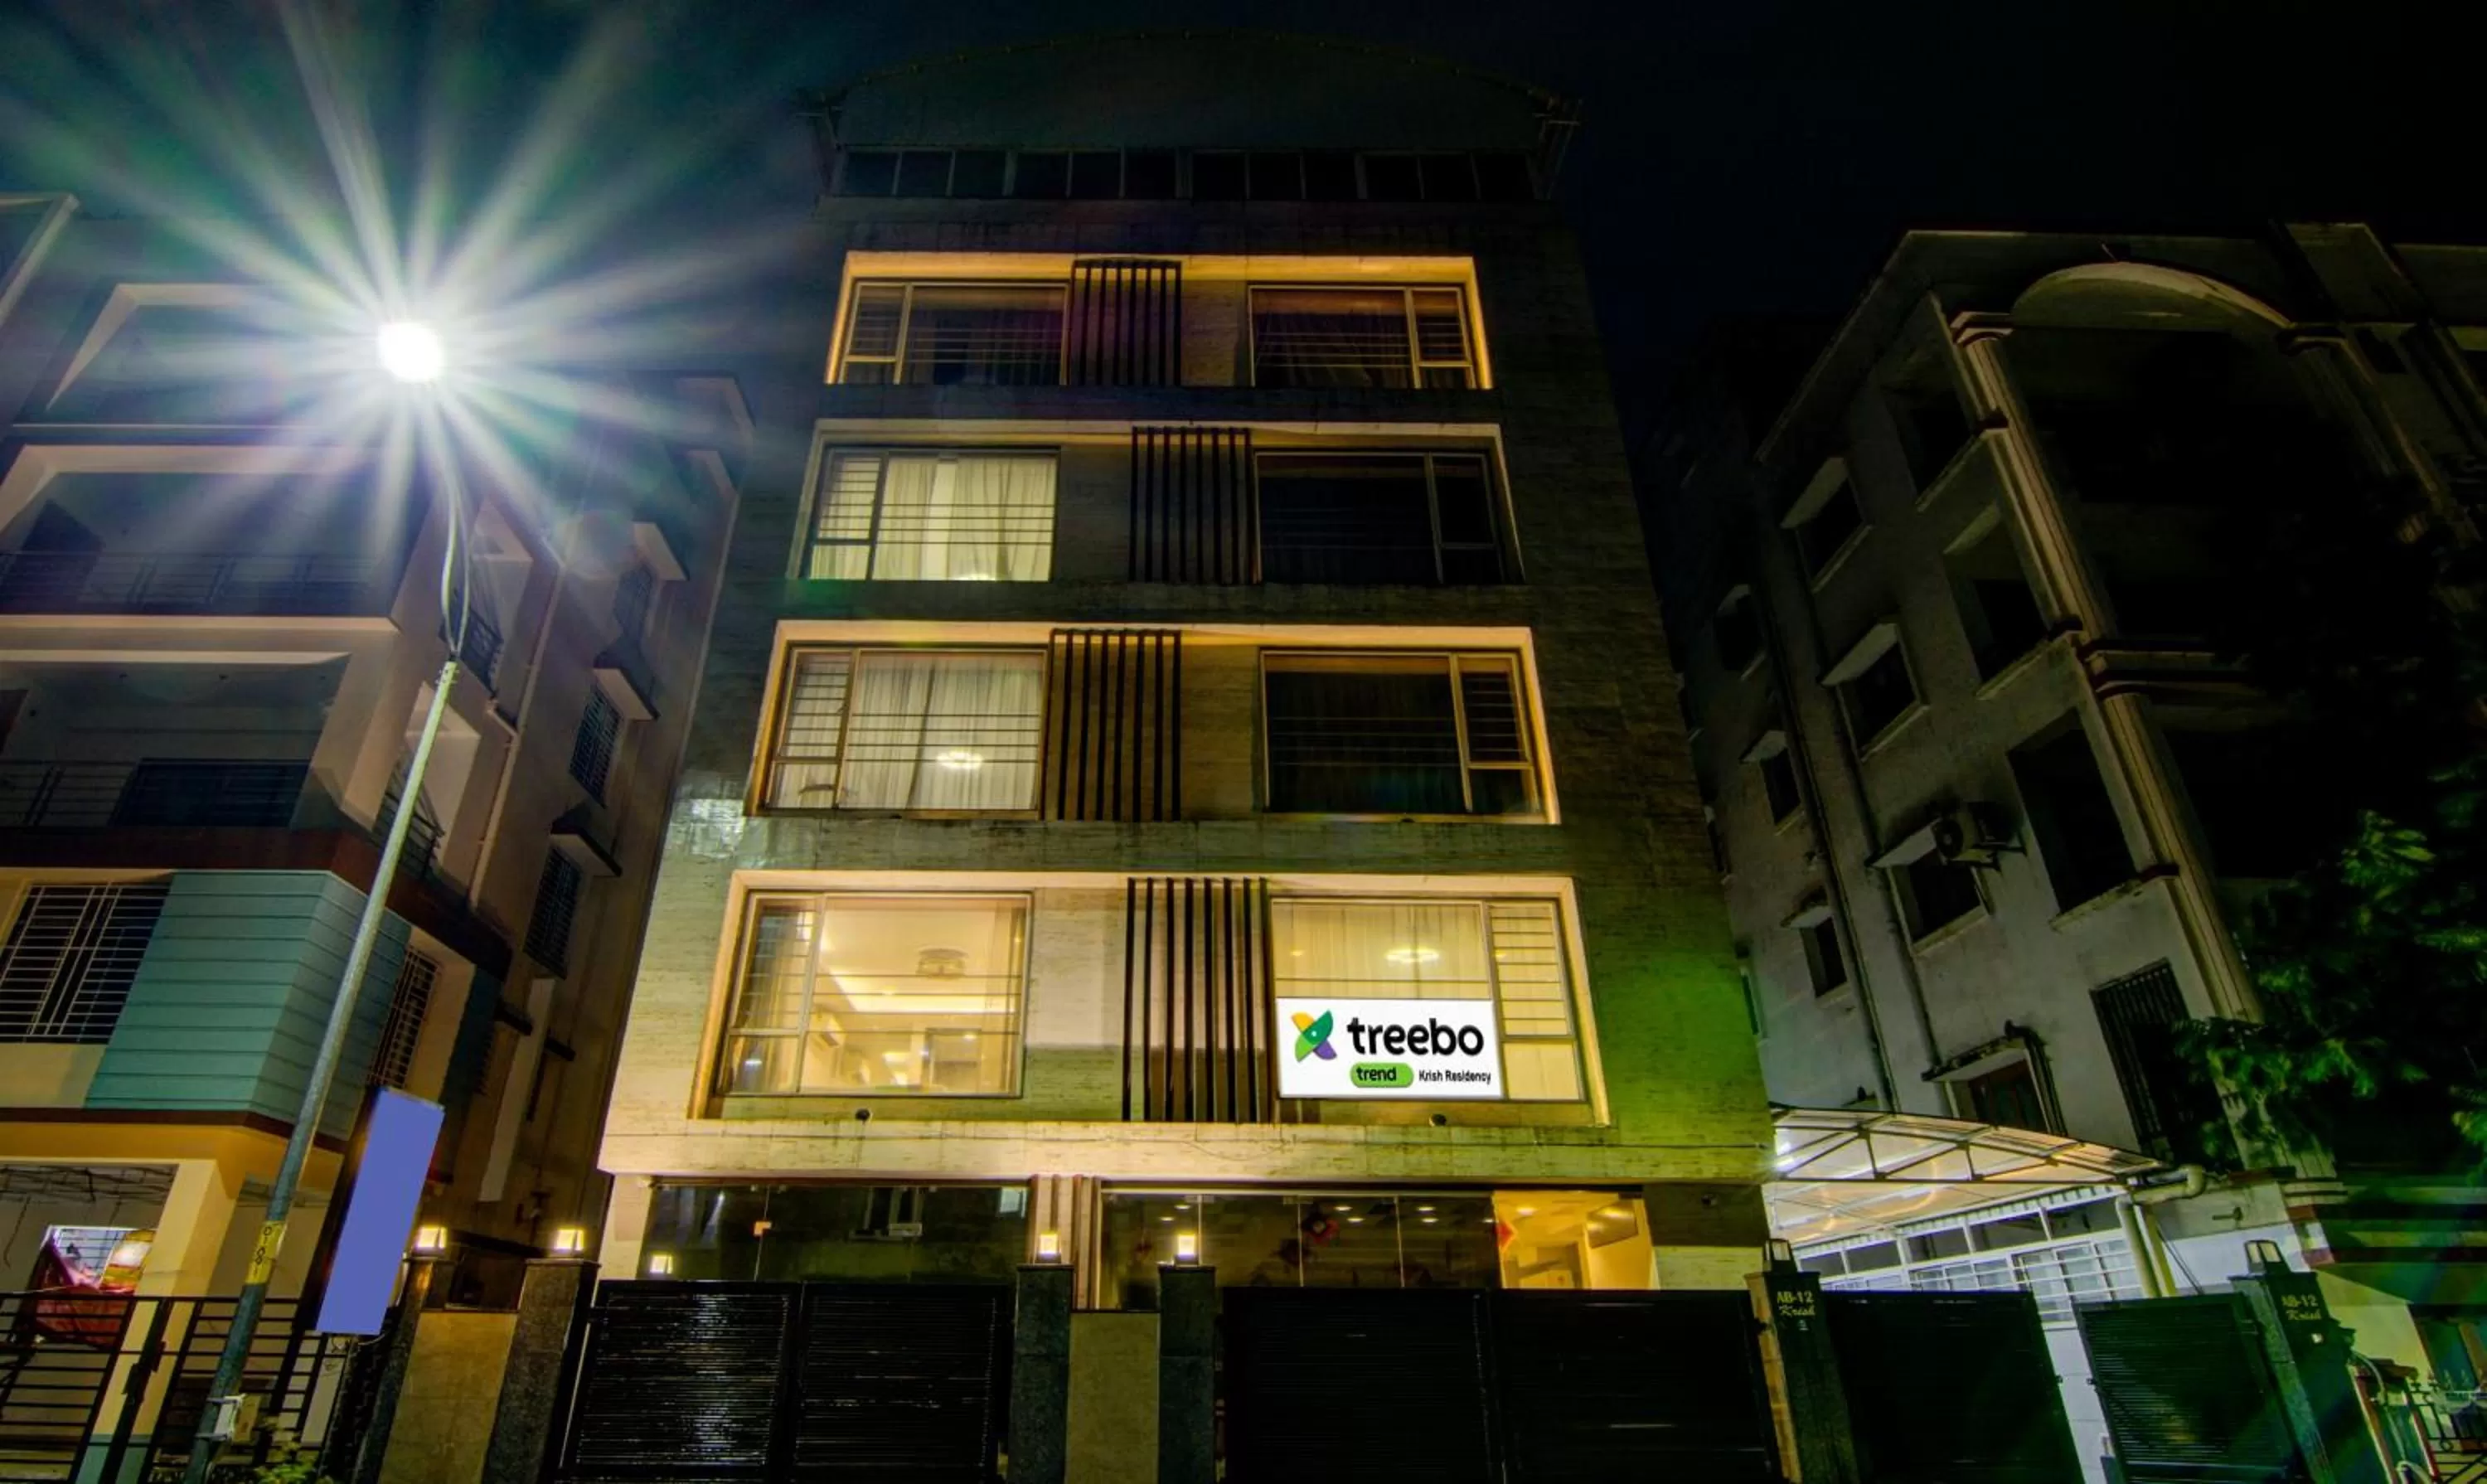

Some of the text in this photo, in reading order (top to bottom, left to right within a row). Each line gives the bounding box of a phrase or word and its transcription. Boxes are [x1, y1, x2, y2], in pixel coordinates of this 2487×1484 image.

[1346, 1017, 1484, 1056] treebo
[1355, 1067, 1397, 1082] trend
[1418, 1069, 1491, 1084] Krish Residency
